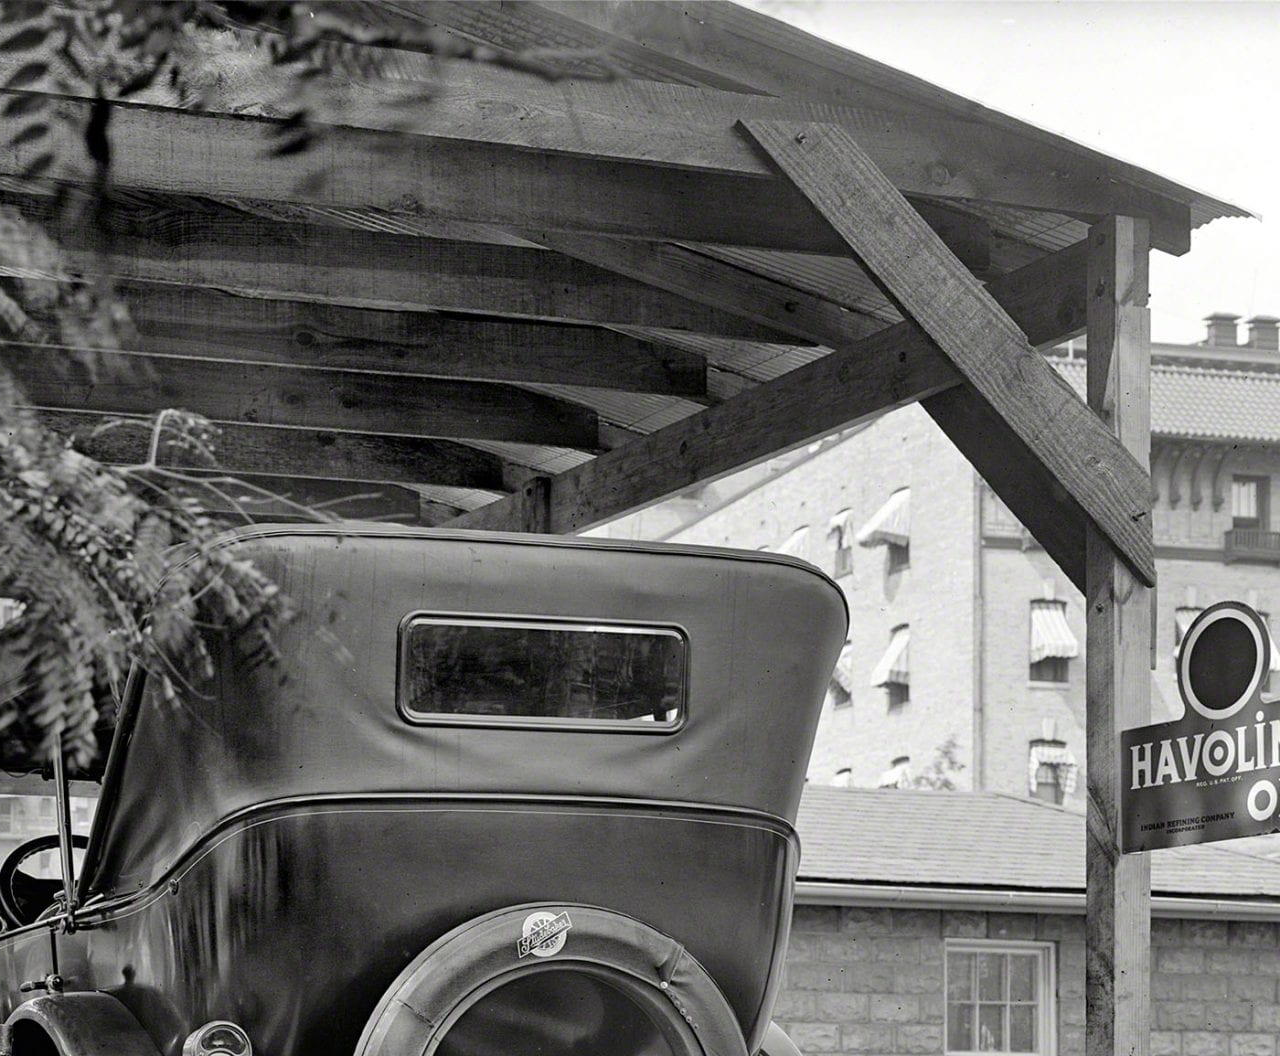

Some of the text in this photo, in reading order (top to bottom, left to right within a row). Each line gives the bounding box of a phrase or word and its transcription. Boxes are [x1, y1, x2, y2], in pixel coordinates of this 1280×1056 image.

[1140, 811, 1236, 832] INDIAN REFINING COMPANY
